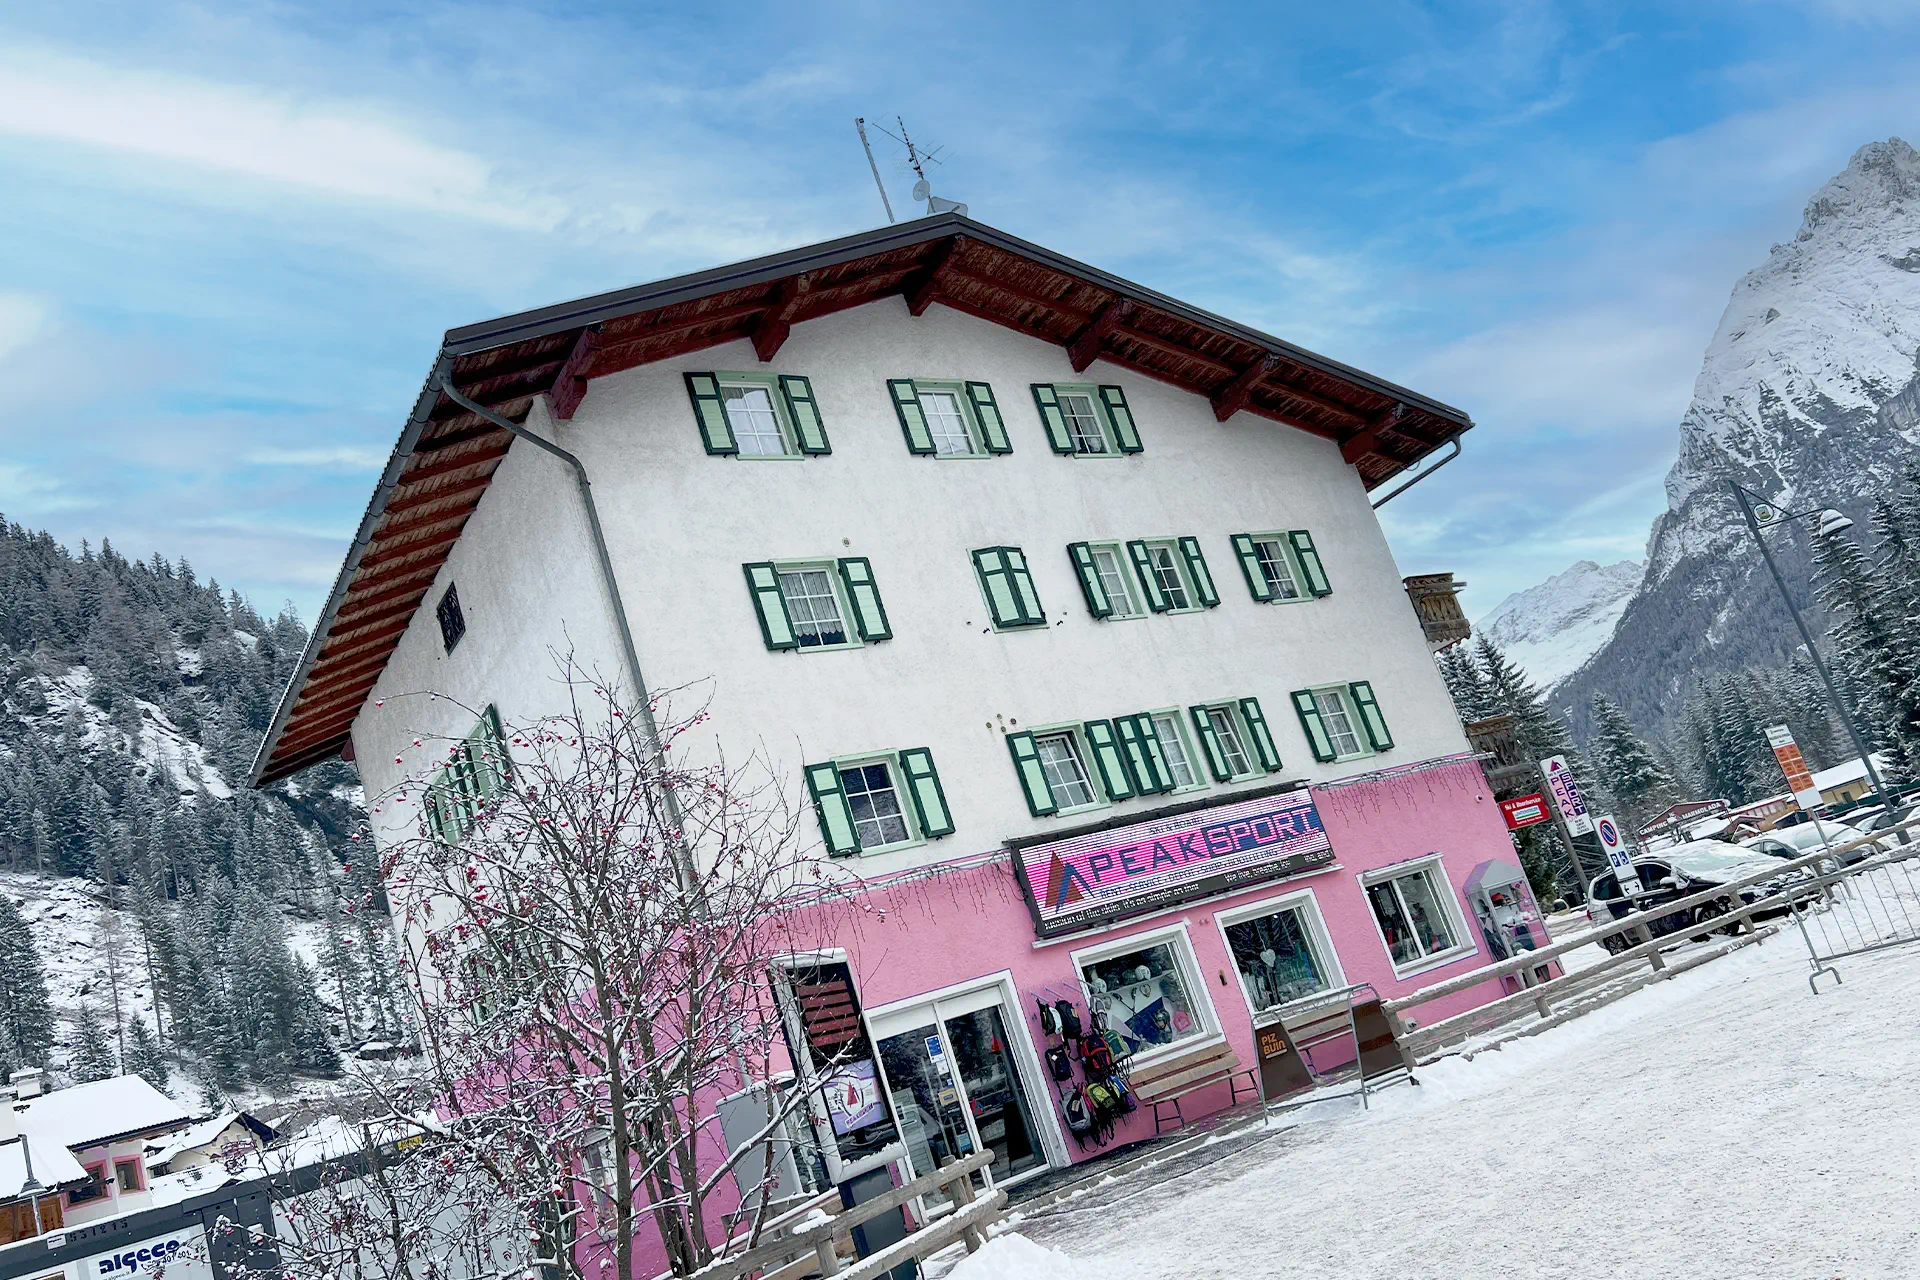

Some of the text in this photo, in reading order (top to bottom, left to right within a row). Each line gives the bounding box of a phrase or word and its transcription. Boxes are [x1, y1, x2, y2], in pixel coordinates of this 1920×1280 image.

[1551, 776, 1574, 818] PEAK
[1561, 773, 1586, 814] SPORT
[1640, 802, 1721, 836] CAMPING MARMOLADA
[1101, 886, 1121, 898] RENT
[1261, 1032, 1277, 1046] PIZ
[98, 1240, 180, 1274] algeco
